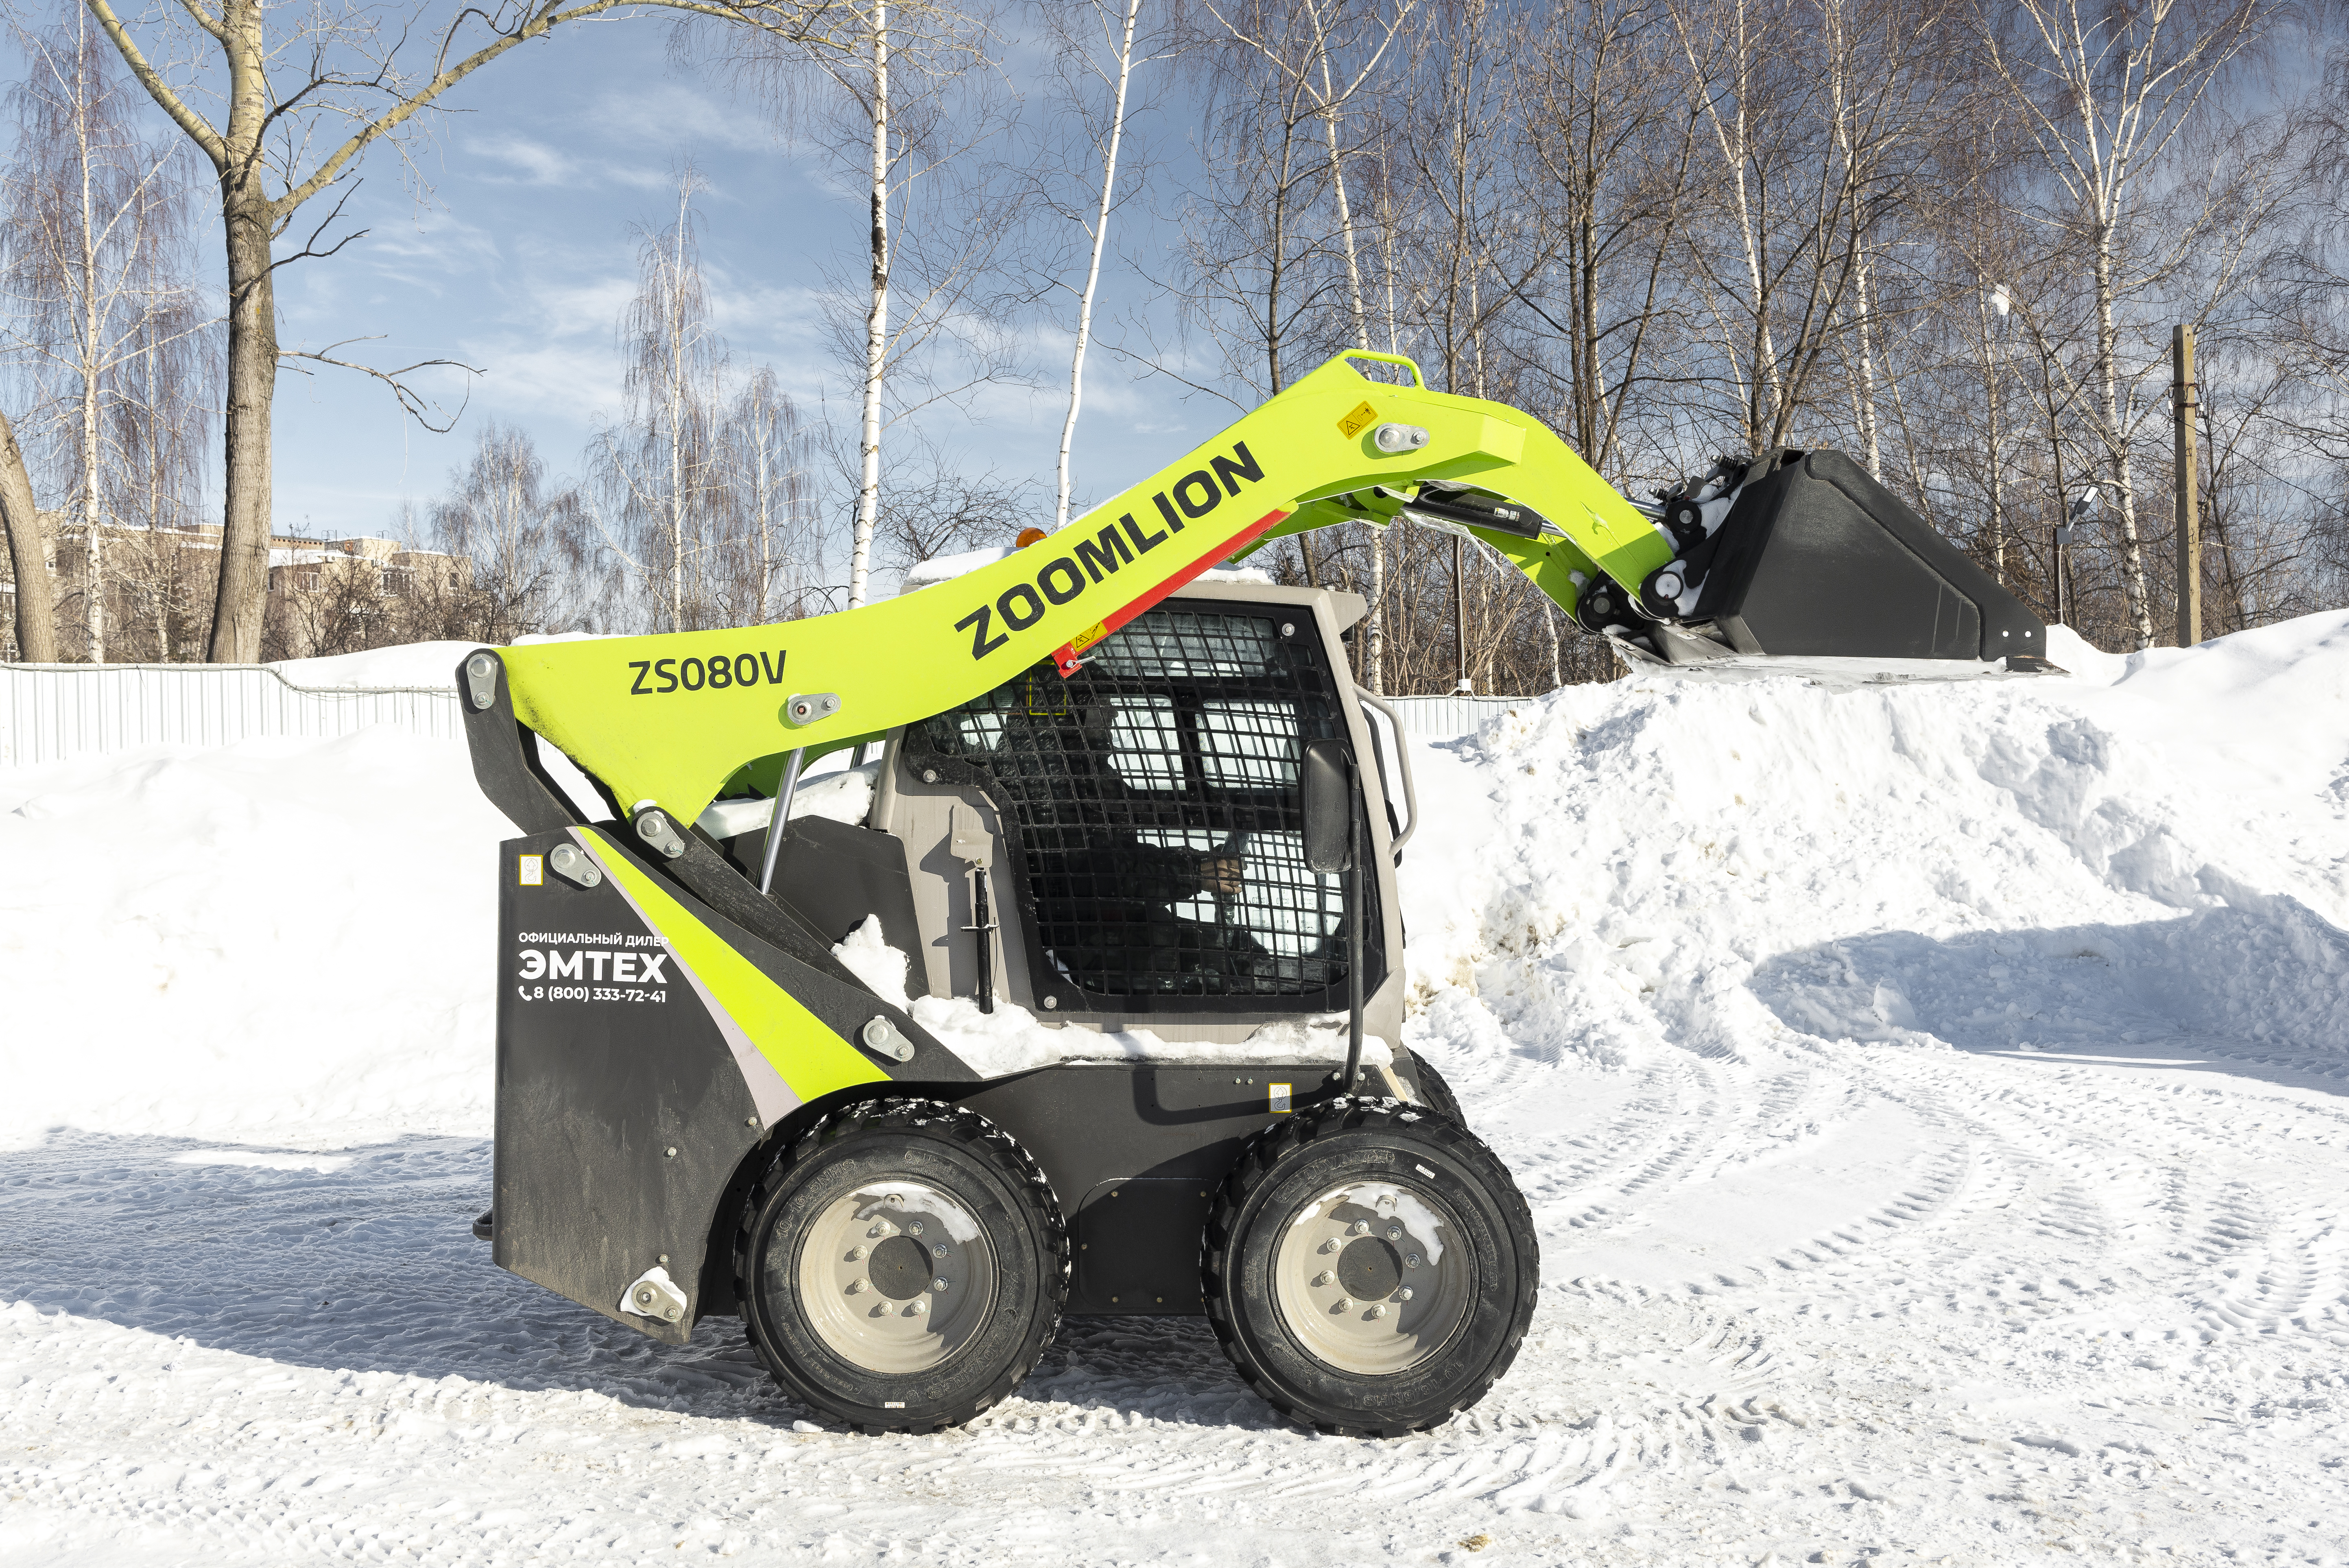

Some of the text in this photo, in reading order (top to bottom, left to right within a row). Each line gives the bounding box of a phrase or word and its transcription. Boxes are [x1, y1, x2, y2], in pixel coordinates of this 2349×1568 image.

[954, 441, 1265, 661] ZOOMLION
[629, 650, 786, 695] ZS080V
[519, 932, 669, 947] ОФИЦИАЛЬНЫЙ ДИЛЕР
[518, 949, 668, 984] ЭМТЕХ
[533, 986, 666, 1003] 8 (800) 333-72-41
[1303, 1152, 1388, 1181] ADVANCE
